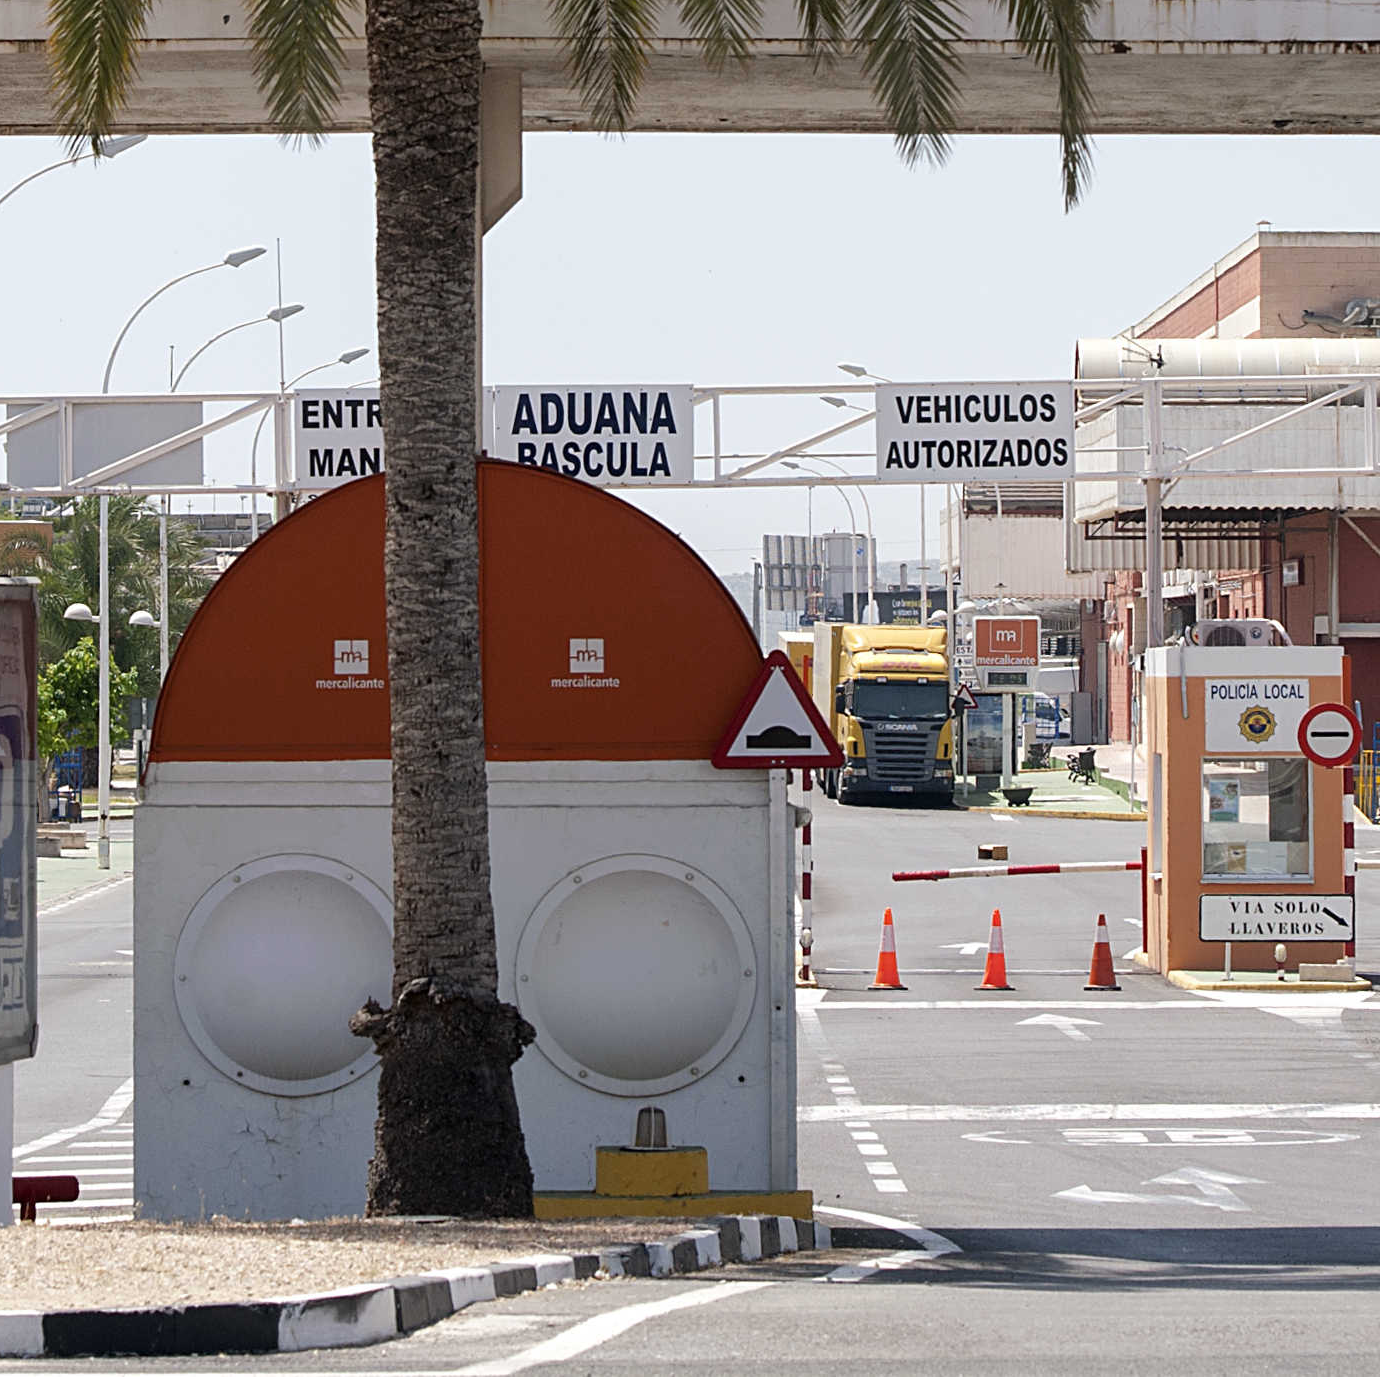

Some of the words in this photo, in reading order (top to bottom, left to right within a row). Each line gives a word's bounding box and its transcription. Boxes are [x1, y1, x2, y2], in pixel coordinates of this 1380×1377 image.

[512, 392, 677, 435] ADUANA
[895, 394, 1056, 423] VEHICULOS
[522, 441, 672, 477] BASCULA
[885, 438, 1068, 469] AUTORIZADOS
[977, 654, 1037, 666] mercalicante
[315, 676, 385, 690] mercalicante
[550, 675, 620, 689] mercalicante
[1264, 684, 1304, 699] LOCAL
[1230, 901, 1264, 914] VIA
[1274, 901, 1321, 914] SOLO
[1230, 922, 1325, 935] LLAVEROS
